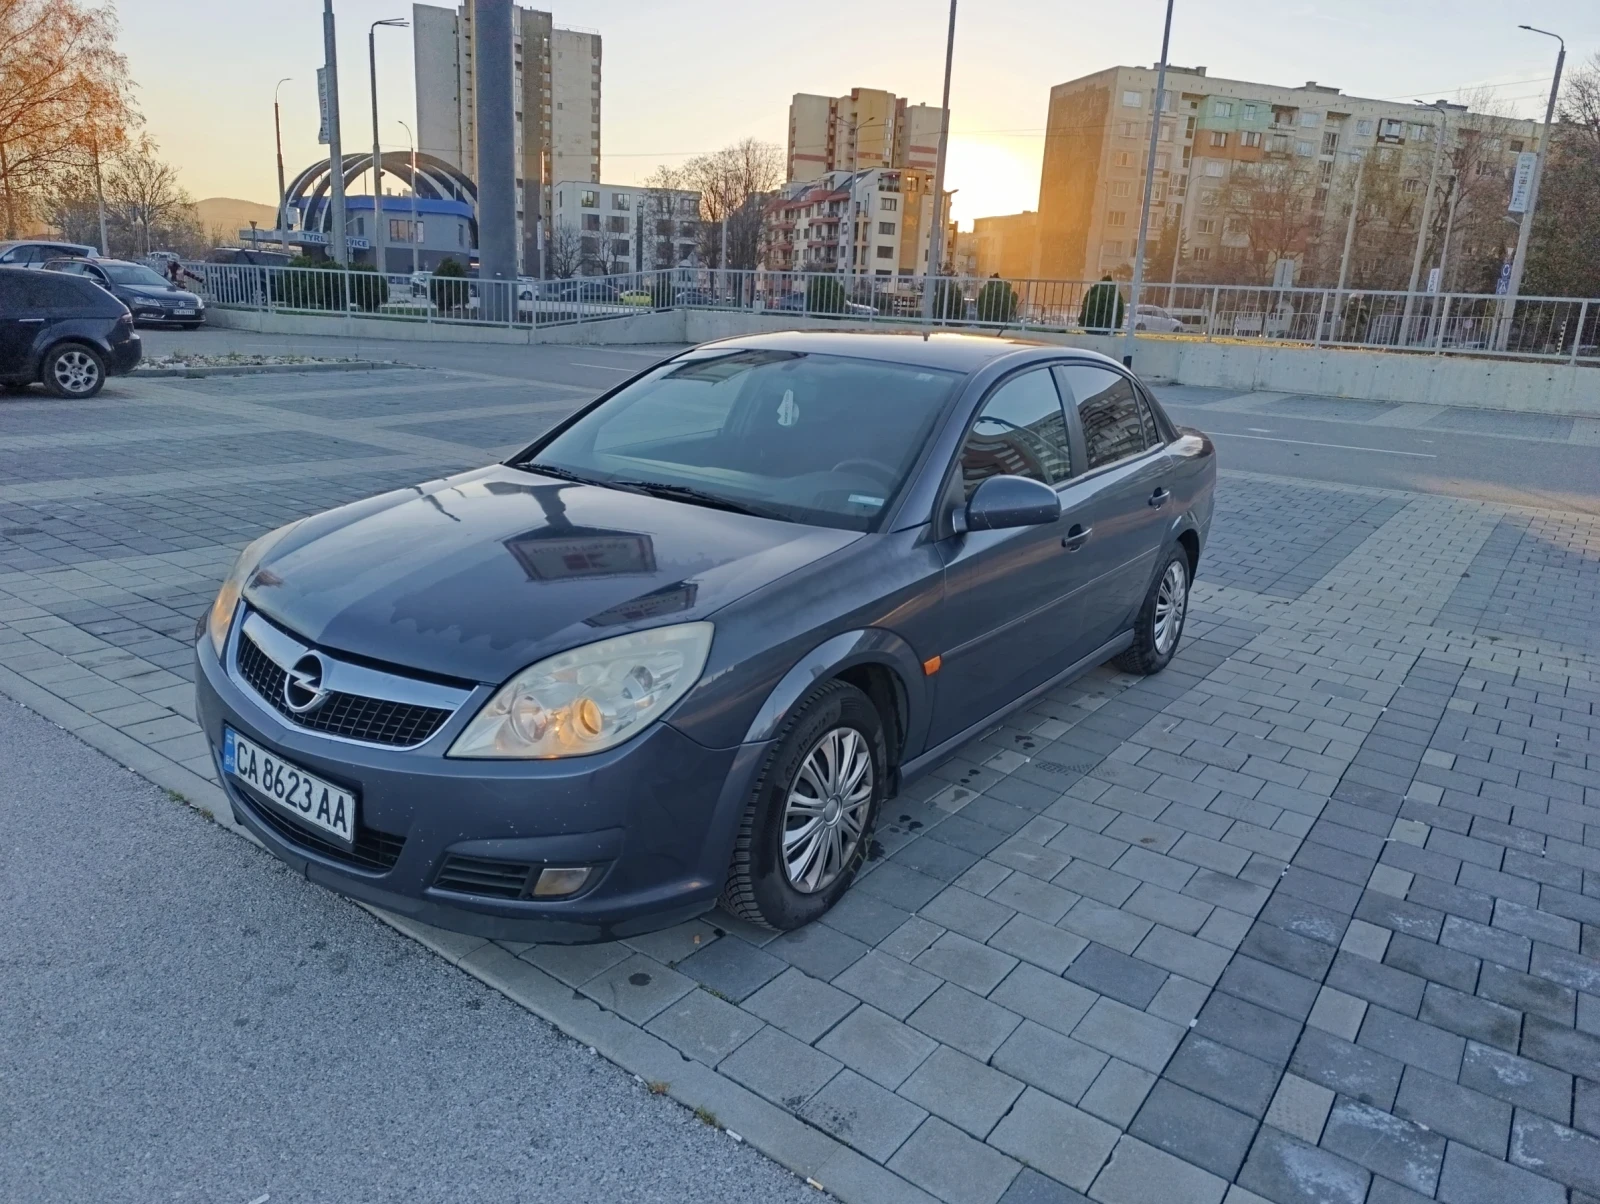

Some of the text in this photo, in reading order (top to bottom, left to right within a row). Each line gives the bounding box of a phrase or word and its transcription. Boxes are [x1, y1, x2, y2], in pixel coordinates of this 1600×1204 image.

[236, 741, 347, 833] CA 8623 AA
